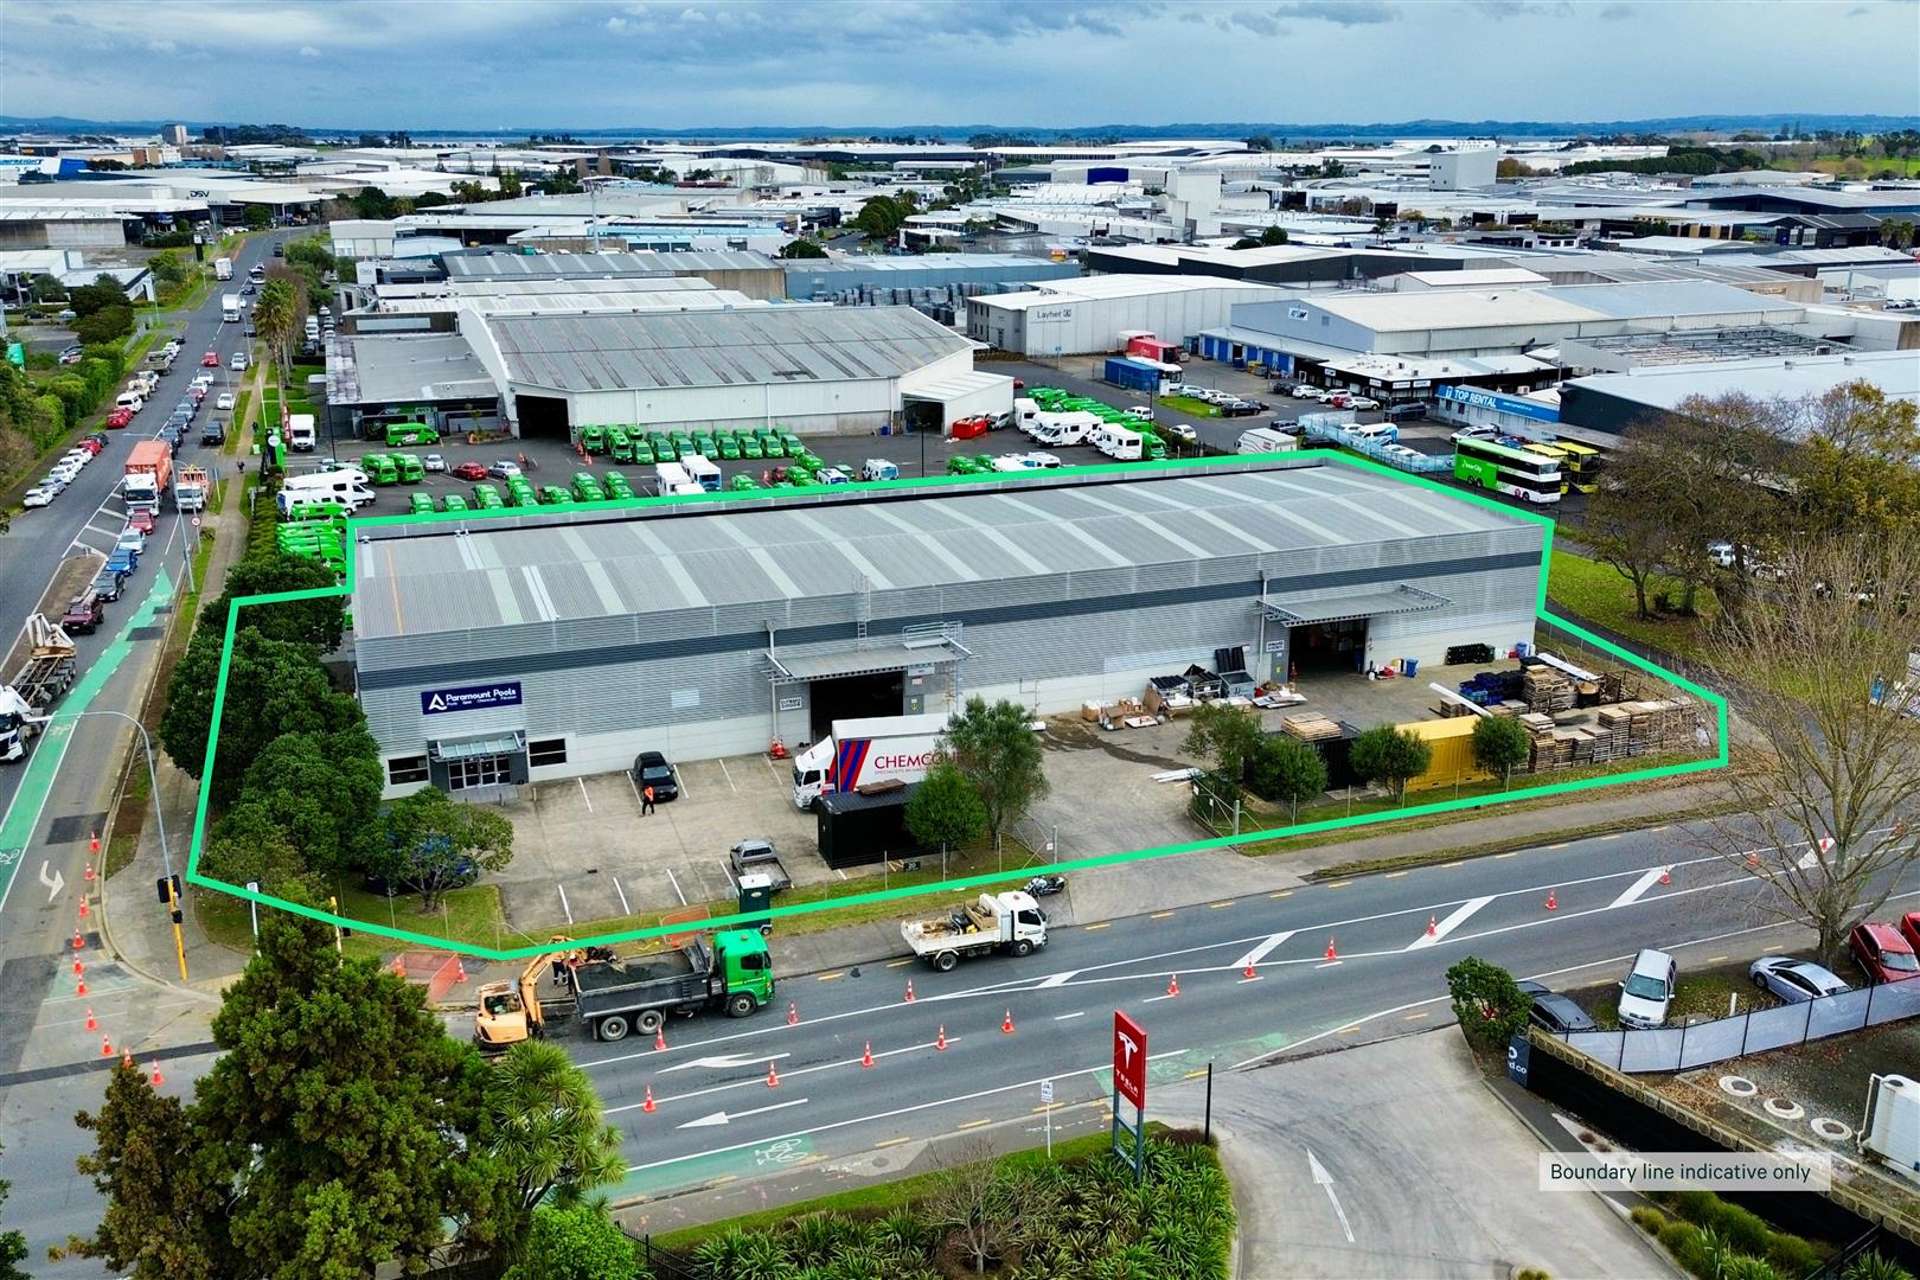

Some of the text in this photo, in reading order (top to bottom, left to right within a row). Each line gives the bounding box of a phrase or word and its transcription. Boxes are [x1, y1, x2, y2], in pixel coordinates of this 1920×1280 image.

[1454, 389, 1470, 401] TOP
[1470, 392, 1497, 408] RENTAL
[446, 690, 491, 702] Paramount
[493, 687, 517, 698] Pools
[1115, 1068, 1139, 1095] TESLA
